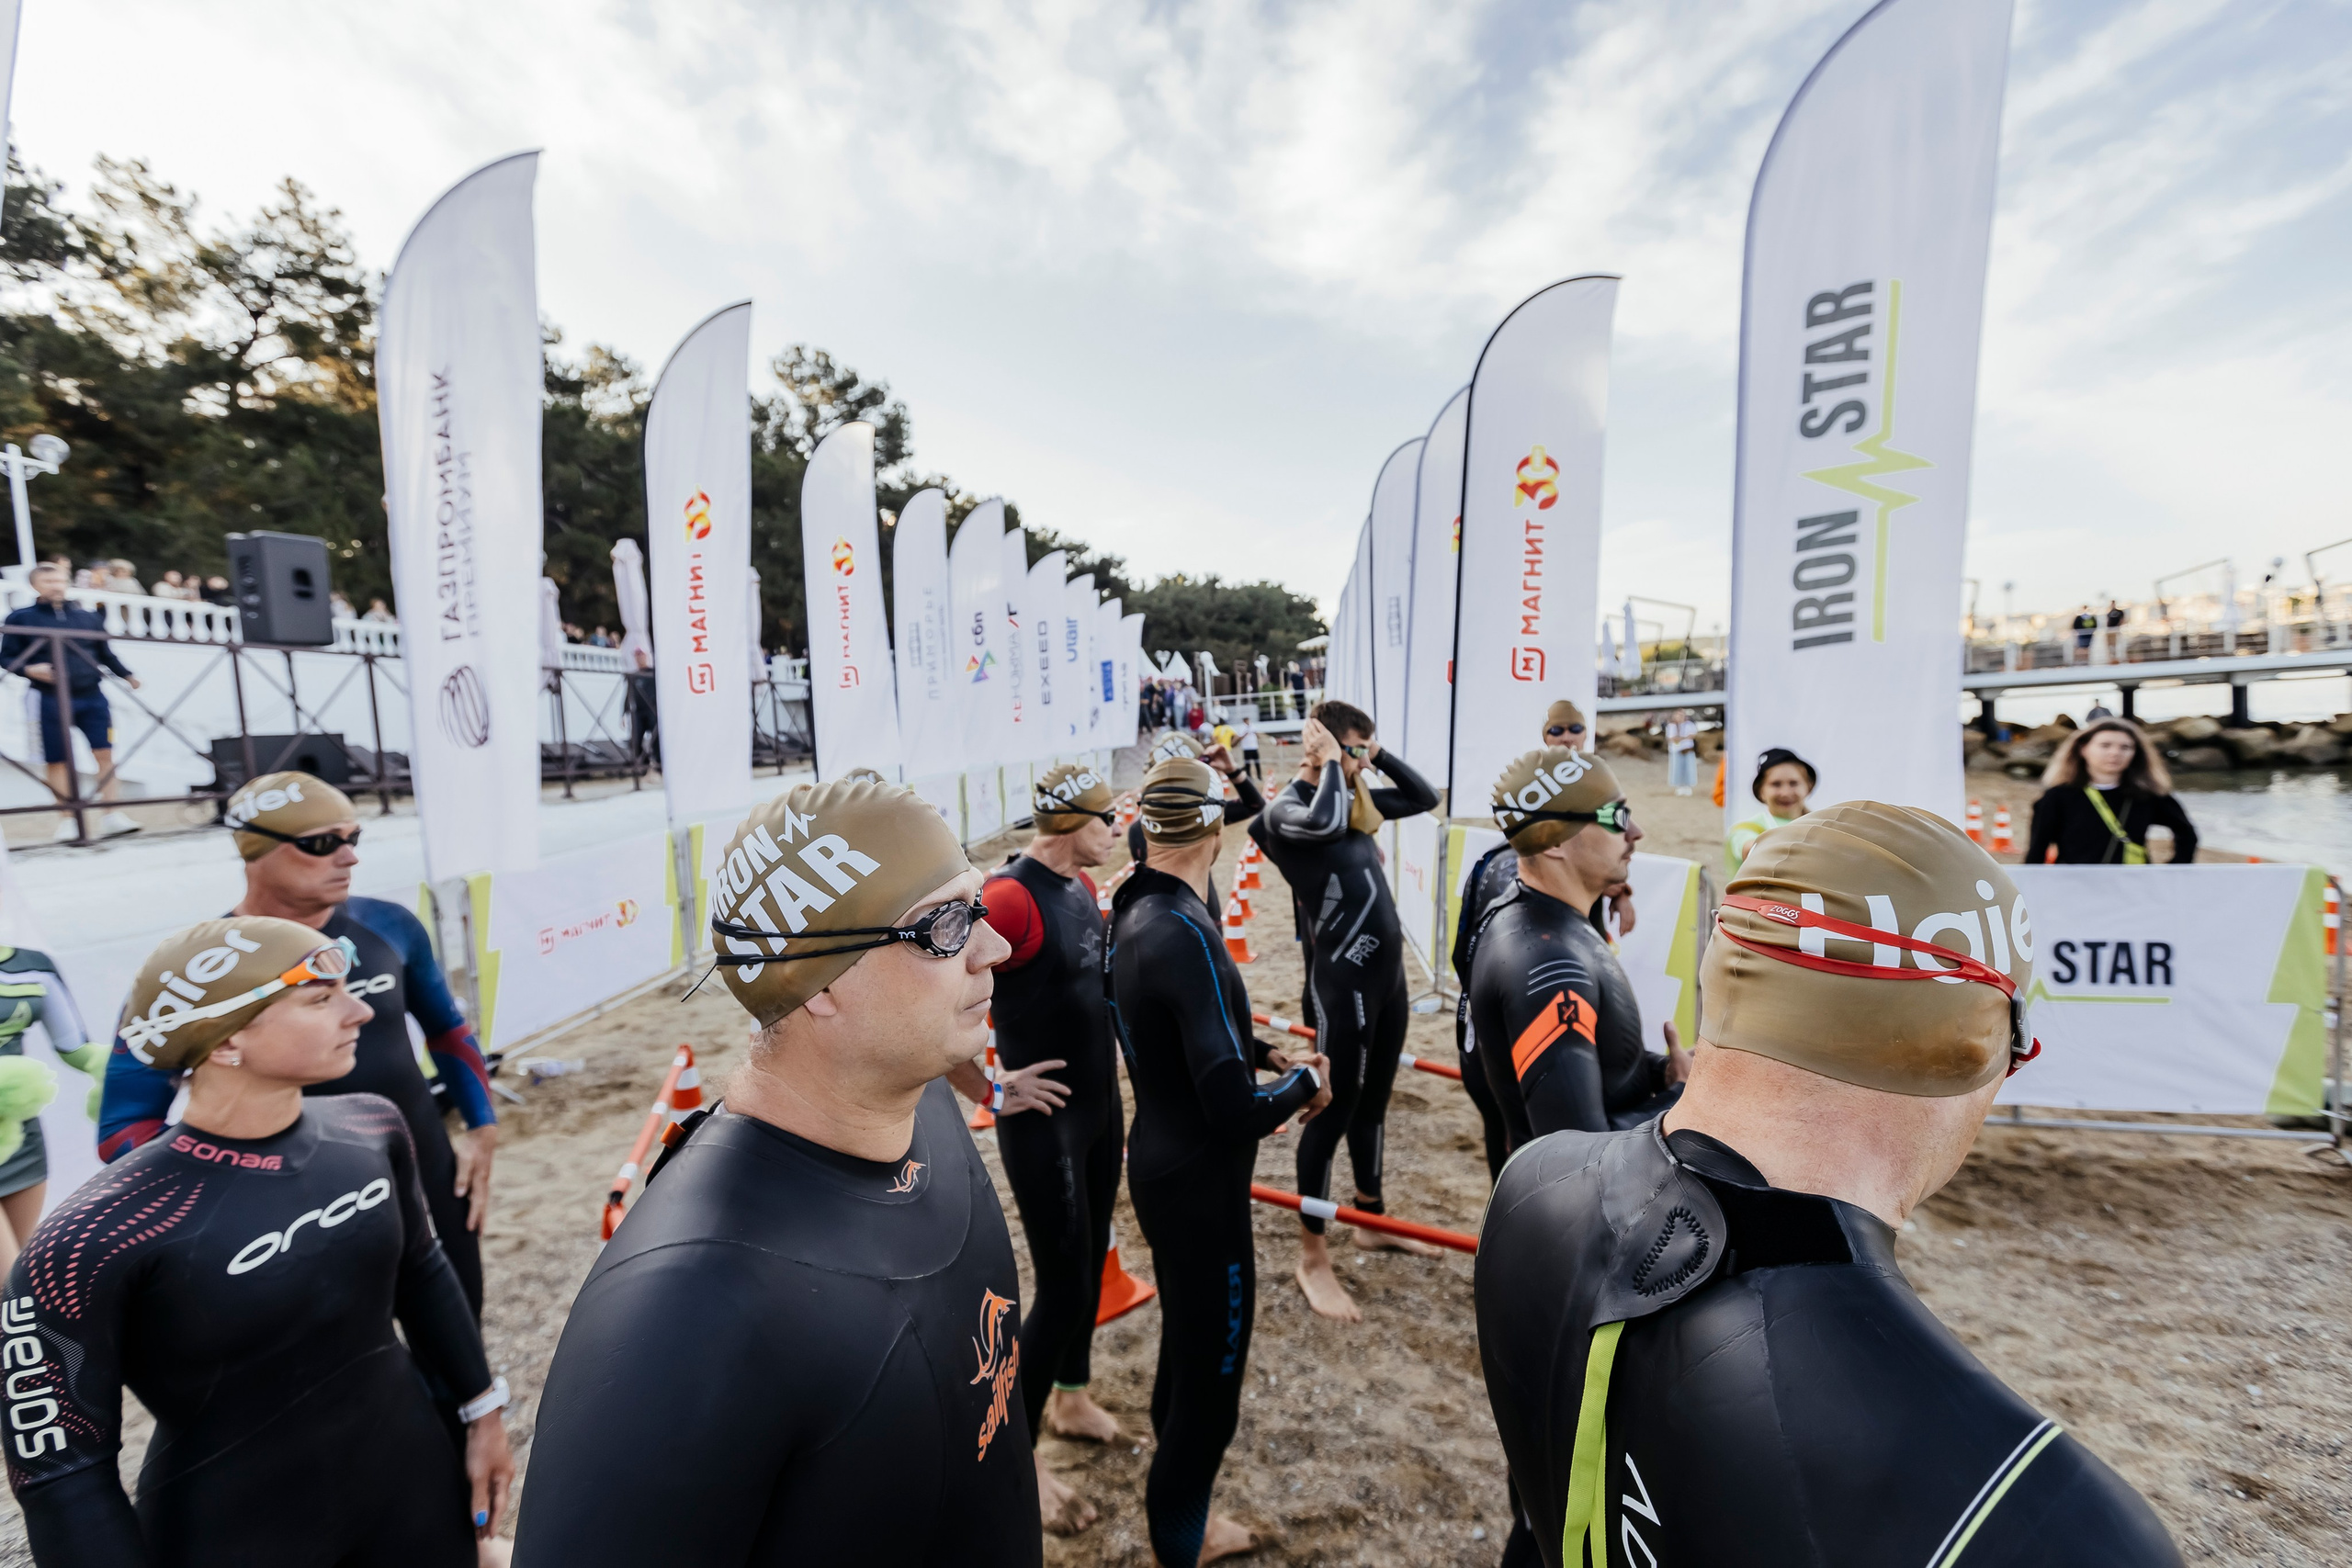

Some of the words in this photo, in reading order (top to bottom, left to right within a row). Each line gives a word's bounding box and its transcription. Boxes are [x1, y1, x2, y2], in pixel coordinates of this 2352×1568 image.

[1798, 279, 1876, 440] STAR
[431, 365, 462, 642] ГАЗПРОМБАНК
[1521, 518, 1546, 636] МАГНИТ
[1792, 508, 1860, 652] IRON
[837, 584, 851, 659] МАГНИТ
[1037, 620, 1051, 705] EXEED
[225, 782, 305, 828] aier
[725, 833, 882, 984] STAR
[898, 931, 917, 940] TYR
[1770, 904, 1801, 920] ZOGGS
[1798, 878, 2034, 985] Haie
[1351, 936, 1381, 967] PRO
[2052, 940, 2175, 986] STAR
[1457, 992, 1469, 1021] ROKA
[977, 1336, 1020, 1462] sailfish
